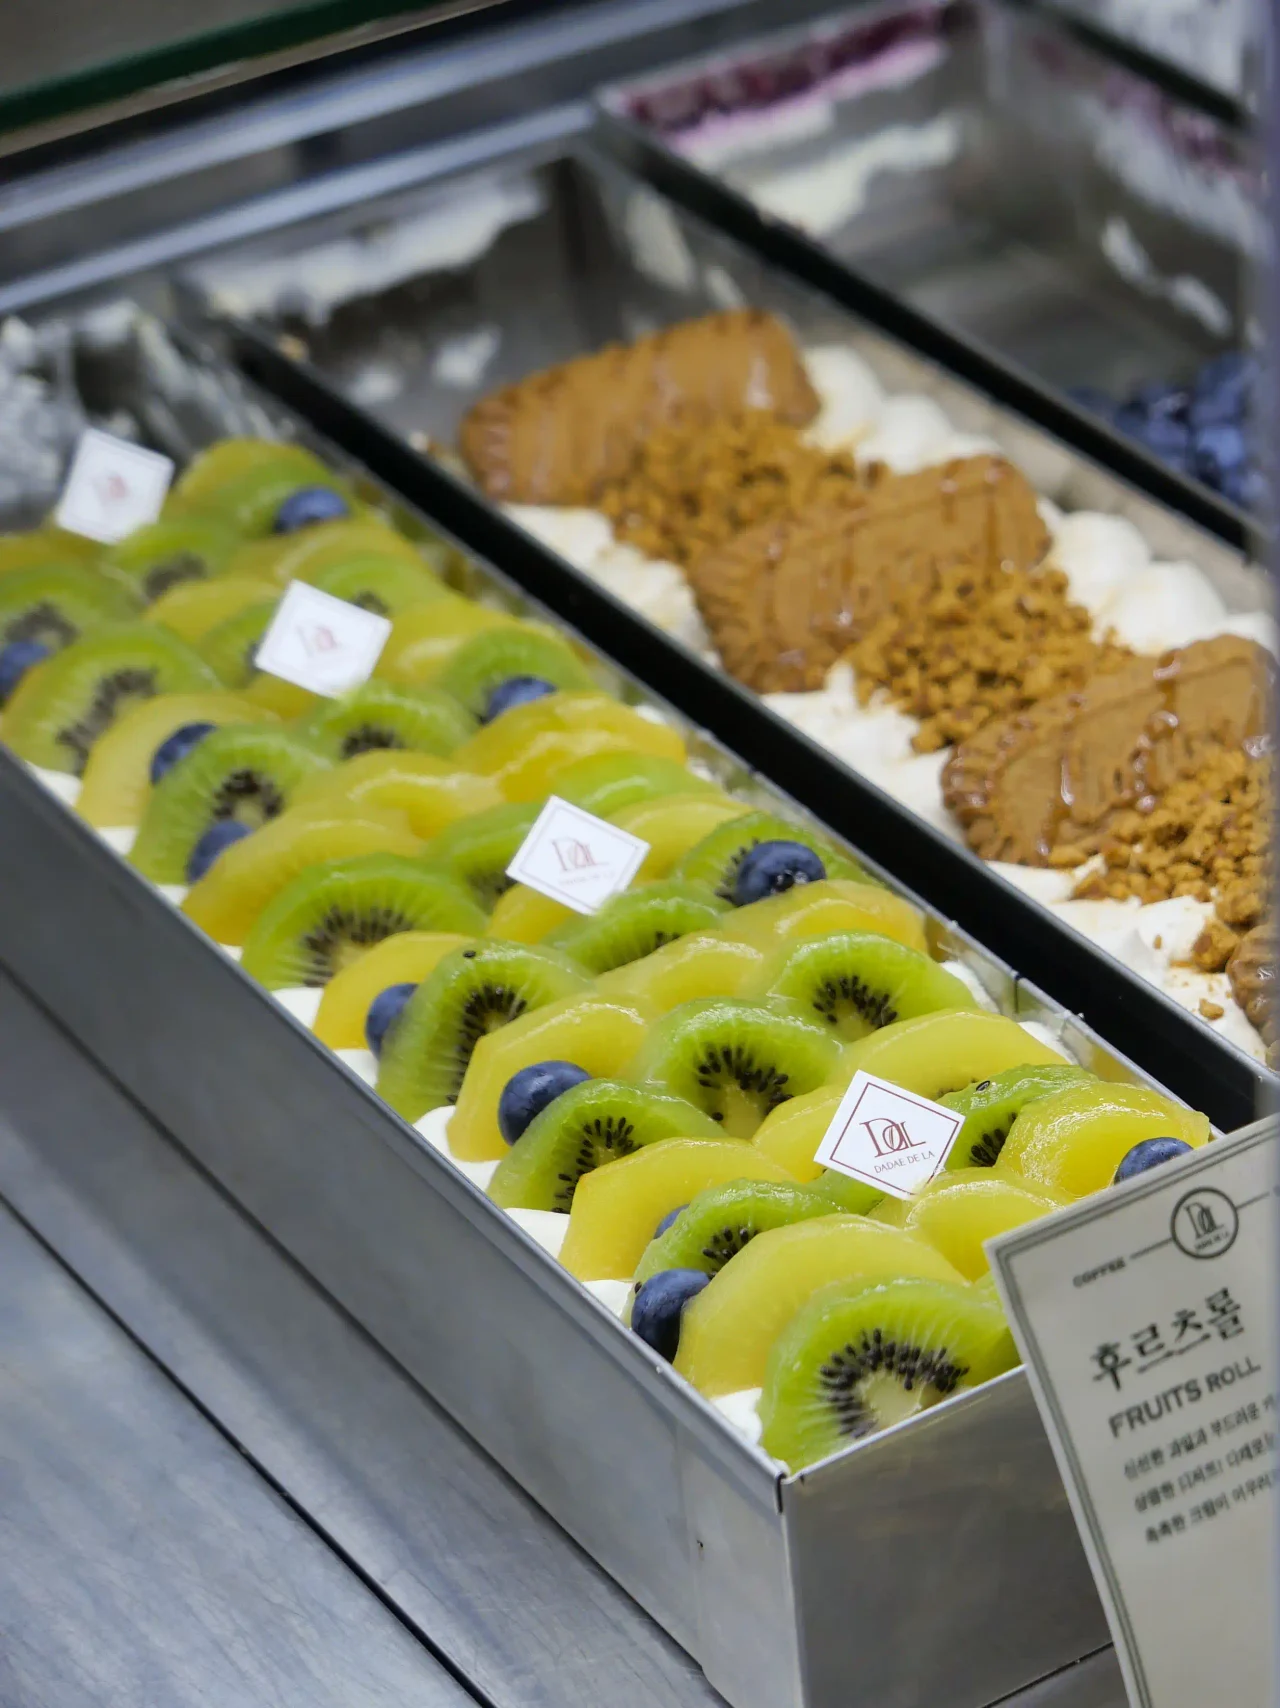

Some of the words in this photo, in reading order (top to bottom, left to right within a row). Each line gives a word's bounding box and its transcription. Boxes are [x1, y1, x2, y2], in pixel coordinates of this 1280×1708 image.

[874, 1158, 906, 1174] DADAE
[907, 1153, 920, 1164] DE
[921, 1150, 935, 1160] LA
[1093, 1287, 1245, 1392] 후르츠롤
[1108, 1378, 1202, 1438] FRUITS
[1205, 1356, 1262, 1394] ROLL
